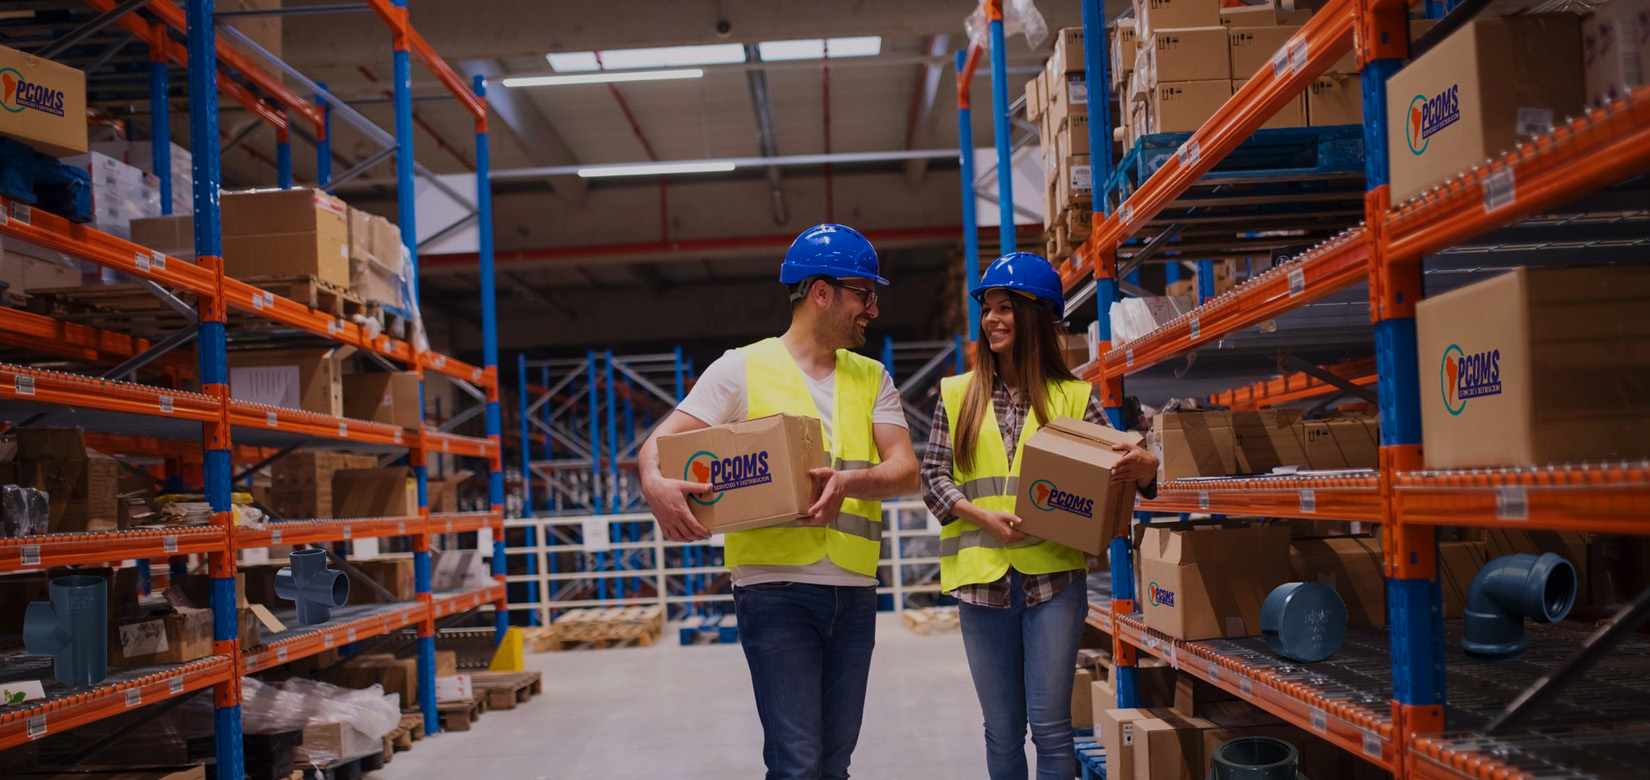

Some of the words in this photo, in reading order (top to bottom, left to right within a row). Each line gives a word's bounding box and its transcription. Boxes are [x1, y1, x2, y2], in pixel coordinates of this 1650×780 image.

[17, 80, 64, 110] PCOMS
[1422, 84, 1459, 130] PCOMS
[1458, 349, 1500, 388] PCOMS
[711, 451, 769, 484] PCOMS
[713, 482, 736, 491] SERVICIOS
[1048, 488, 1094, 513] PCOMS
